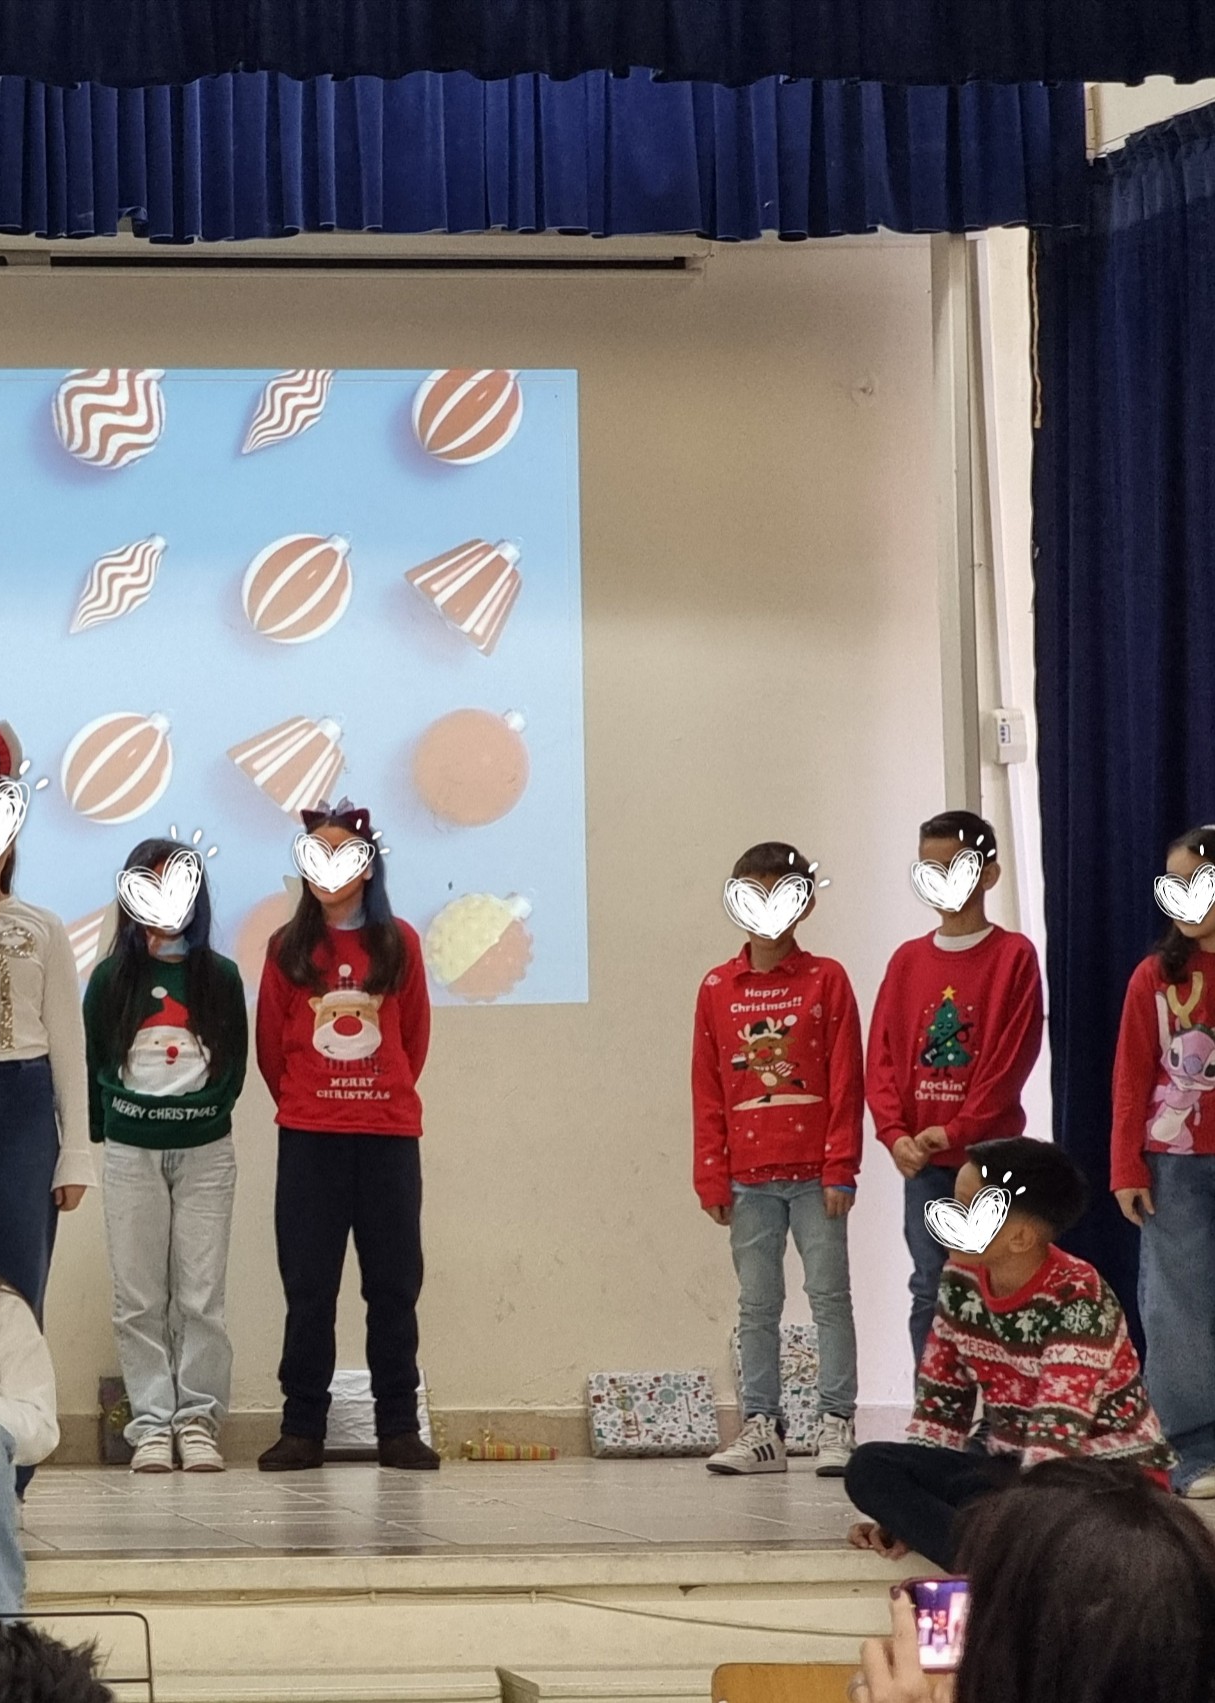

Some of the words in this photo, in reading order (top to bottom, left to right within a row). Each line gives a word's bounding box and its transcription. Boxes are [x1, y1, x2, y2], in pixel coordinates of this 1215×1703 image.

[745, 987, 789, 998] Happy
[730, 996, 802, 1013] Christmas!!
[330, 1077, 374, 1087] MERRY
[316, 1089, 390, 1100] CHRISTMAS
[112, 1096, 145, 1119] MERRY
[148, 1105, 218, 1120] CHRISTMAS
